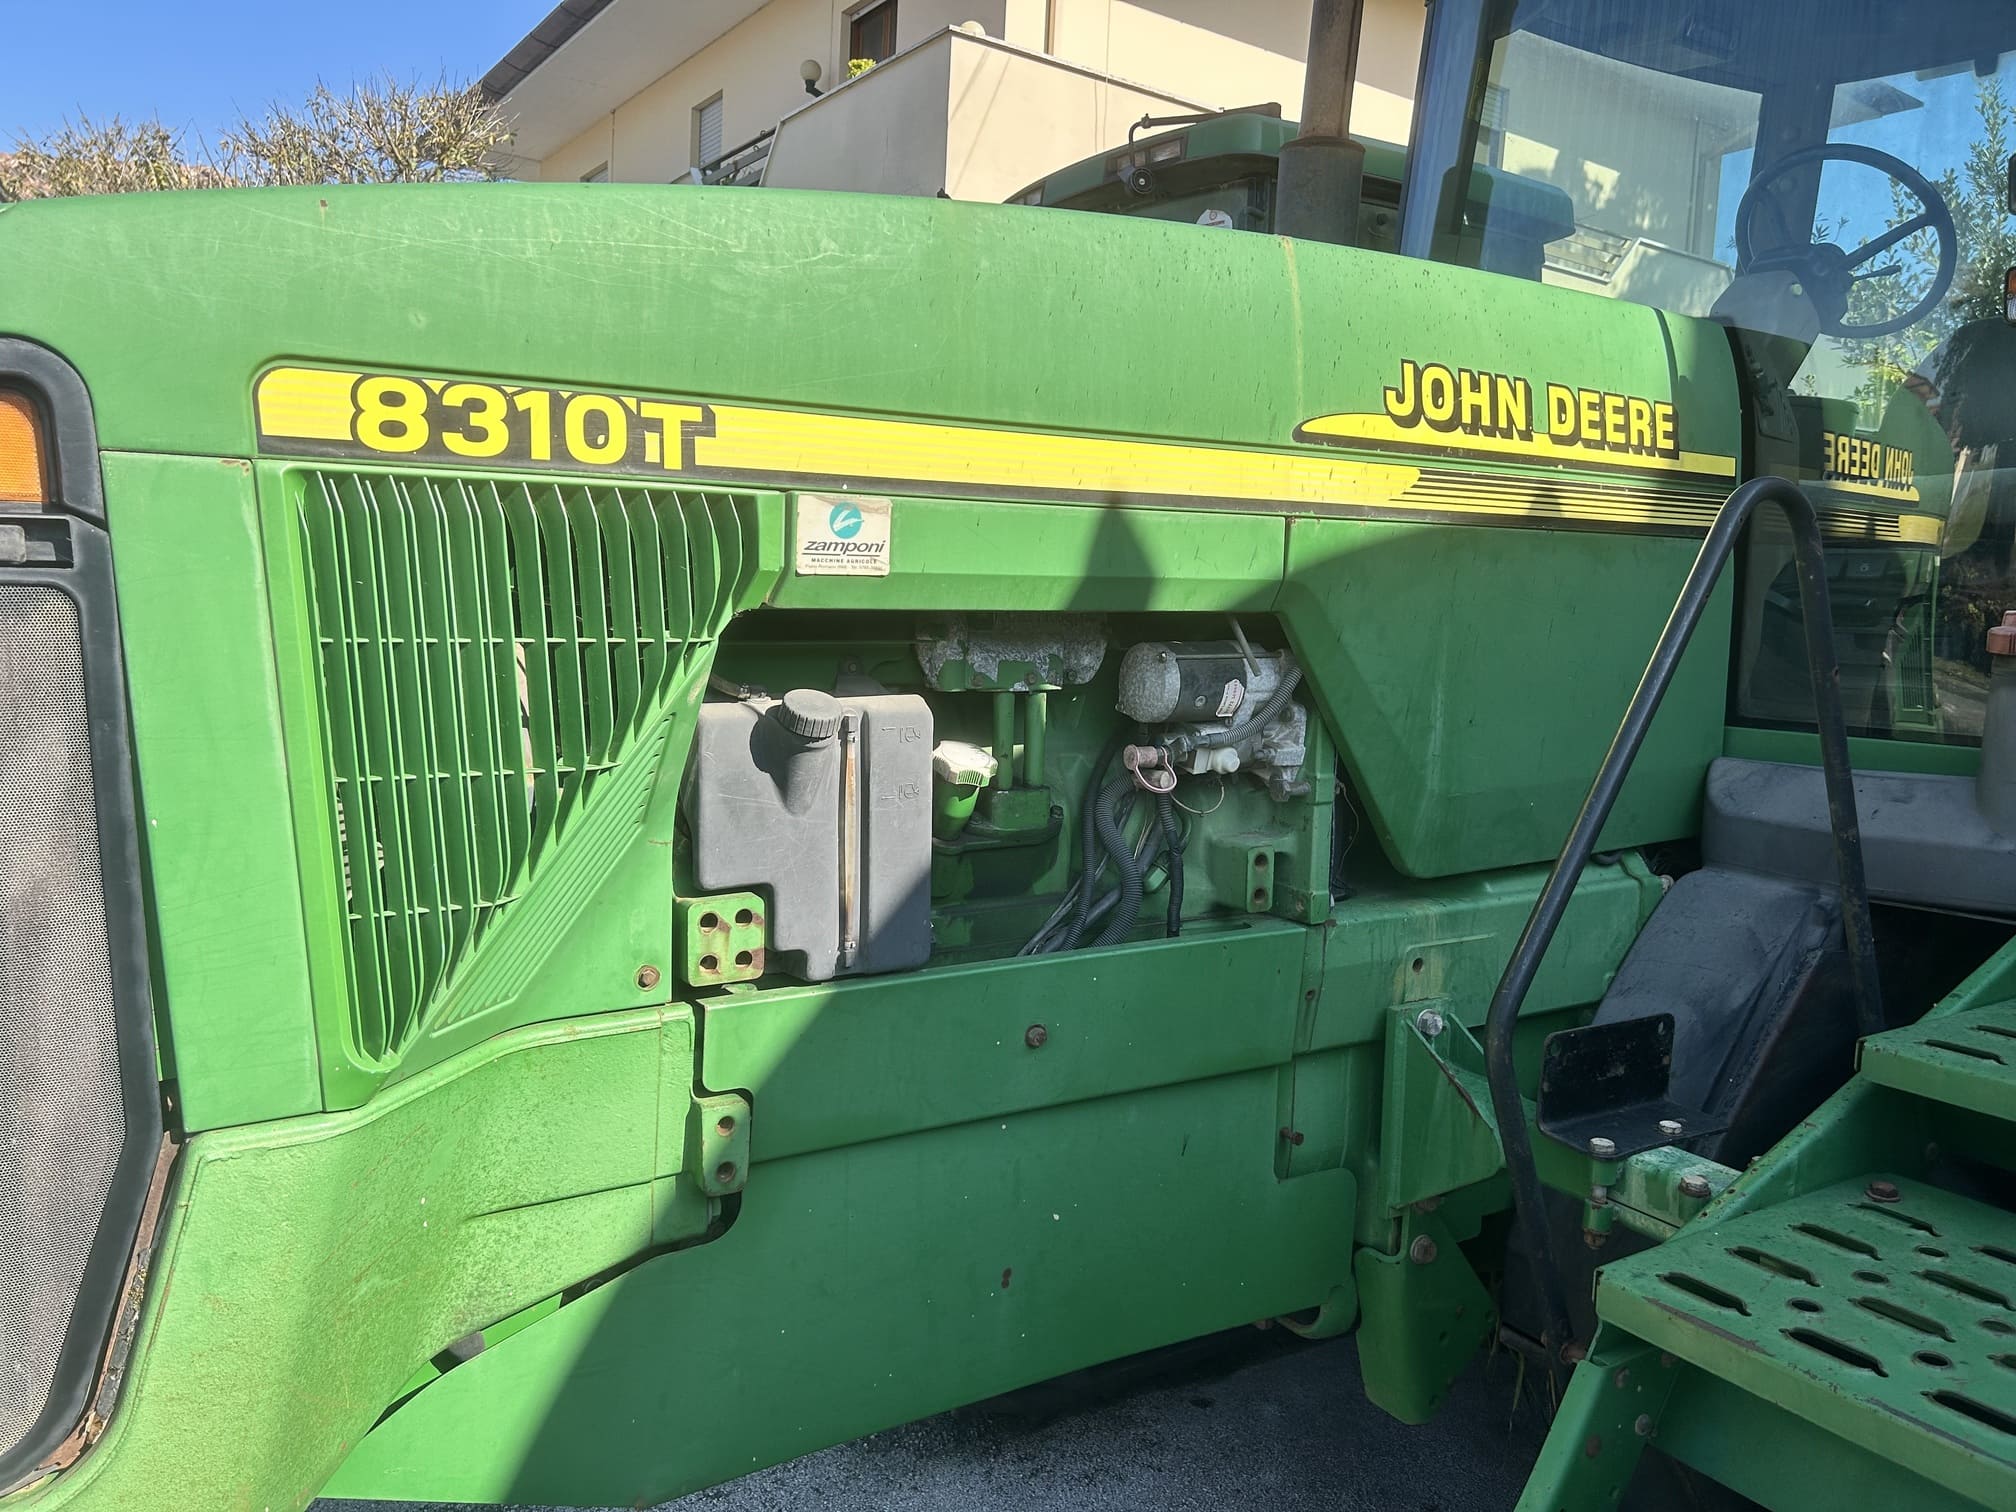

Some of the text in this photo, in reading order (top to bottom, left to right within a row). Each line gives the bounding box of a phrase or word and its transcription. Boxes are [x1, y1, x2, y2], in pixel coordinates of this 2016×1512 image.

[355, 375, 704, 471] 8310T
[1384, 360, 1678, 457] JOHN DEERE
[804, 540, 886, 555] zamponi
